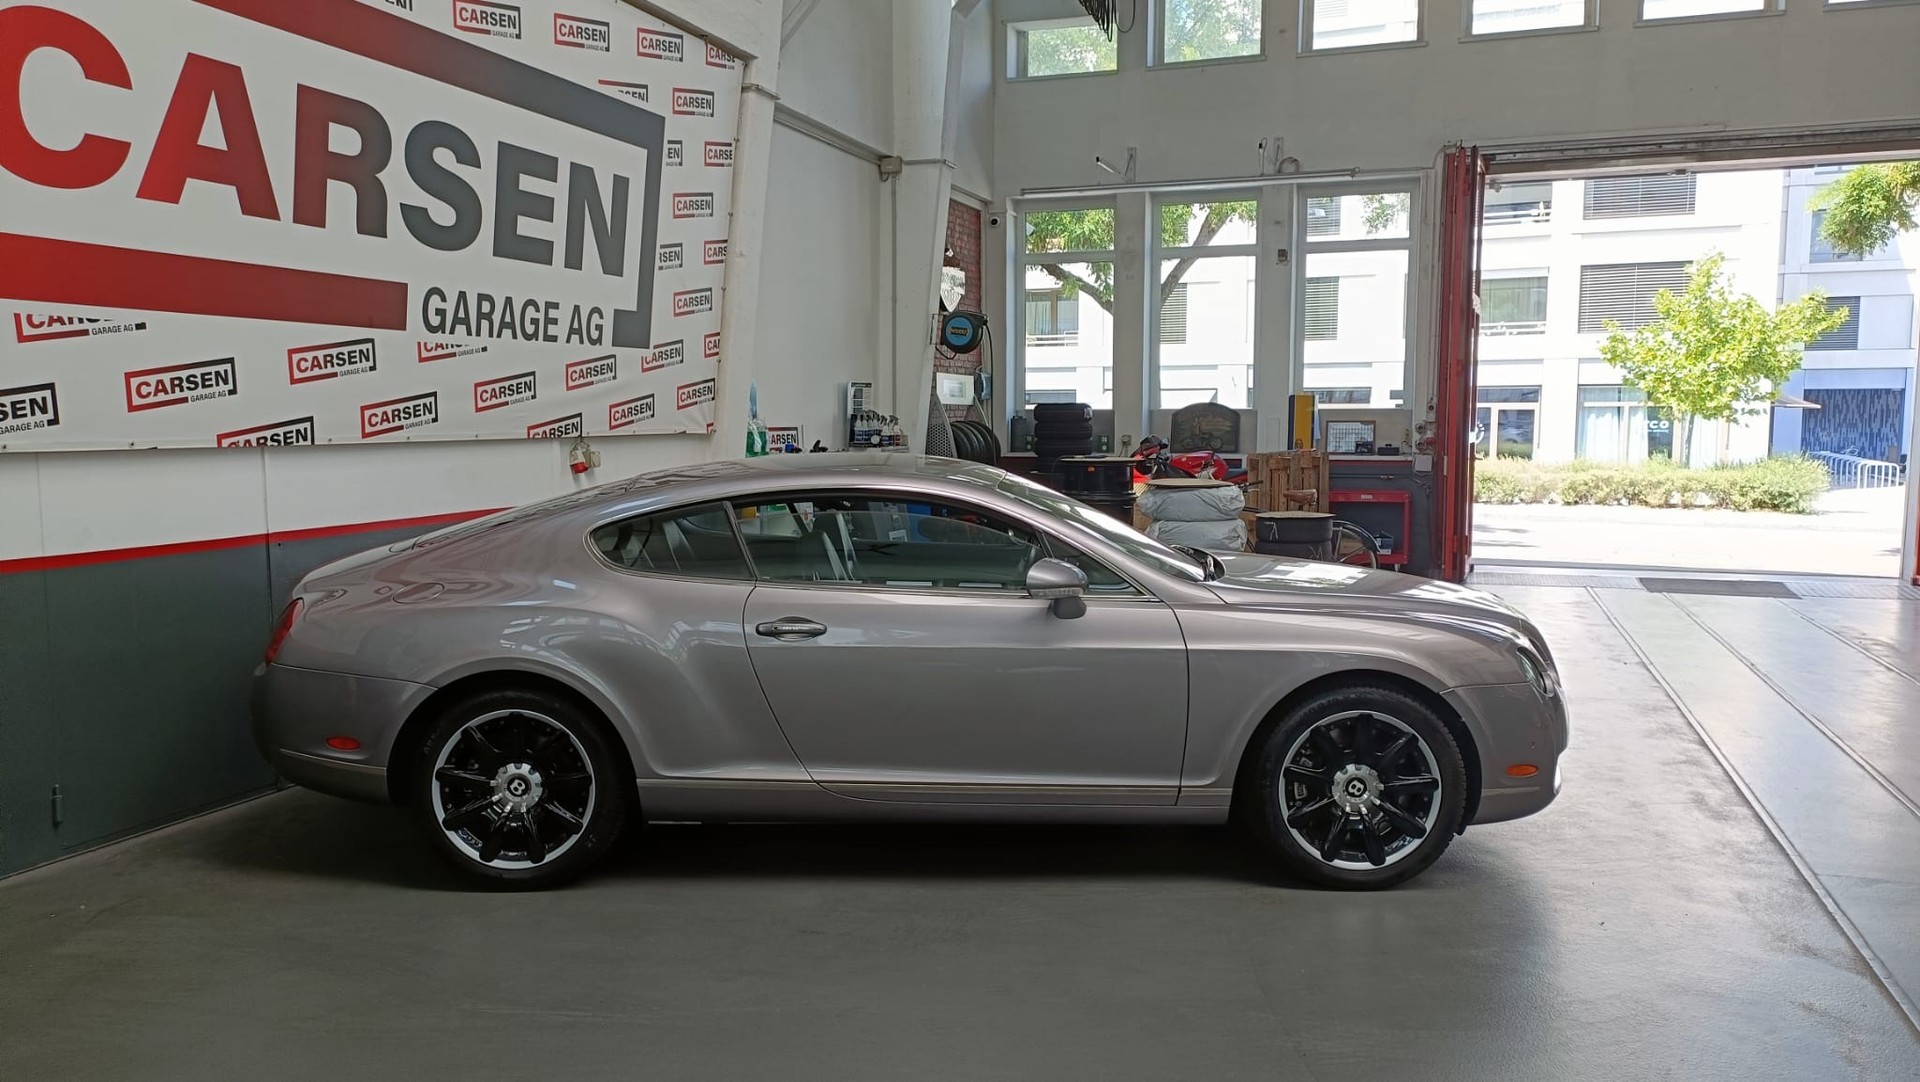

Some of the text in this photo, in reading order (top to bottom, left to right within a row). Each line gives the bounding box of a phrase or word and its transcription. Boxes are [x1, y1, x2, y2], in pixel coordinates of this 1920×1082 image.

[460, 7, 517, 29] CARSEN
[559, 23, 606, 43] CARSEN
[641, 37, 680, 54] CARSEN
[676, 96, 711, 110] CARSEN
[0, 5, 629, 277] CARSEN
[707, 148, 732, 160] CARSE
[676, 199, 711, 212] CARSEN
[707, 246, 727, 258] CARS
[677, 294, 710, 309] CARSEN
[422, 287, 604, 346] GARAGE AG
[91, 324, 133, 335] GARAGE AG
[296, 348, 370, 373] CARSEN
[339, 368, 360, 377] GARAGE
[570, 362, 613, 382] CARSEN
[135, 369, 229, 399] CARSEN
[480, 380, 532, 403] CARSEN
[190, 393, 216, 402] GARAGE
[680, 385, 713, 402] CARSEN
[367, 401, 433, 428] CARSEN
[613, 401, 652, 421] CARSEN
[0, 420, 45, 435] GARAGE AG
[405, 420, 423, 430] GARAGE
[770, 433, 796, 445] ARSEN
